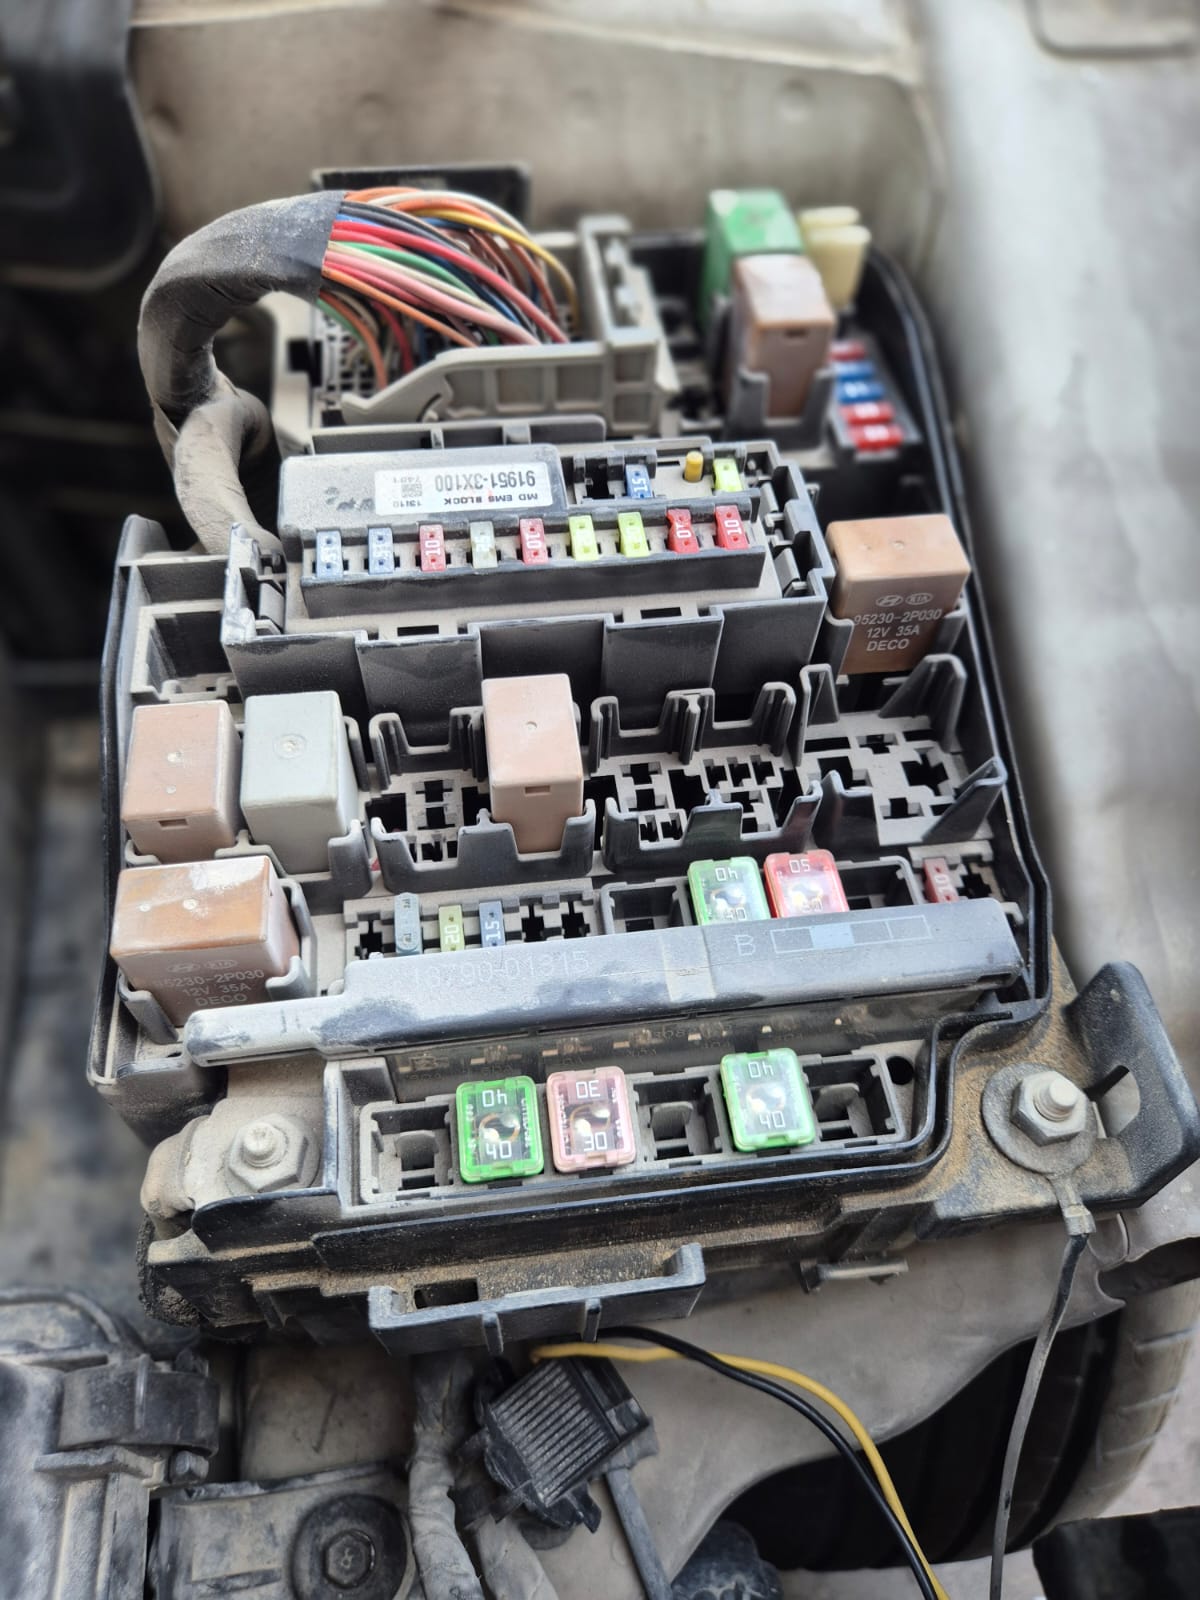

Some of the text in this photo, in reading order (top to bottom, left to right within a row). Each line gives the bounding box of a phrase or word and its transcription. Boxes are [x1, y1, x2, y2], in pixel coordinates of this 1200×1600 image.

[435, 470, 536, 492] 91951-3X100
[631, 476, 649, 494] 15
[444, 493, 538, 505] MD EMS BLOCK
[675, 521, 692, 539] 10
[723, 519, 742, 536] 10
[424, 540, 442, 557] 10
[526, 530, 542, 549] 10
[854, 609, 942, 625] 95230-2P030
[866, 624, 920, 639] 12V 35A
[866, 638, 910, 651] DECO
[715, 867, 739, 882] 40
[789, 859, 811, 873] 50
[443, 924, 460, 945] 20
[484, 921, 501, 941] 15
[733, 933, 757, 957] B
[182, 982, 252, 997] 12V 35A
[195, 993, 248, 1007] DECO
[747, 1061, 774, 1079] 40
[576, 1079, 601, 1099] 30
[482, 1089, 508, 1108] 40
[760, 1110, 786, 1129] 40
[486, 1140, 512, 1160] 40
[583, 1131, 608, 1151] 30
